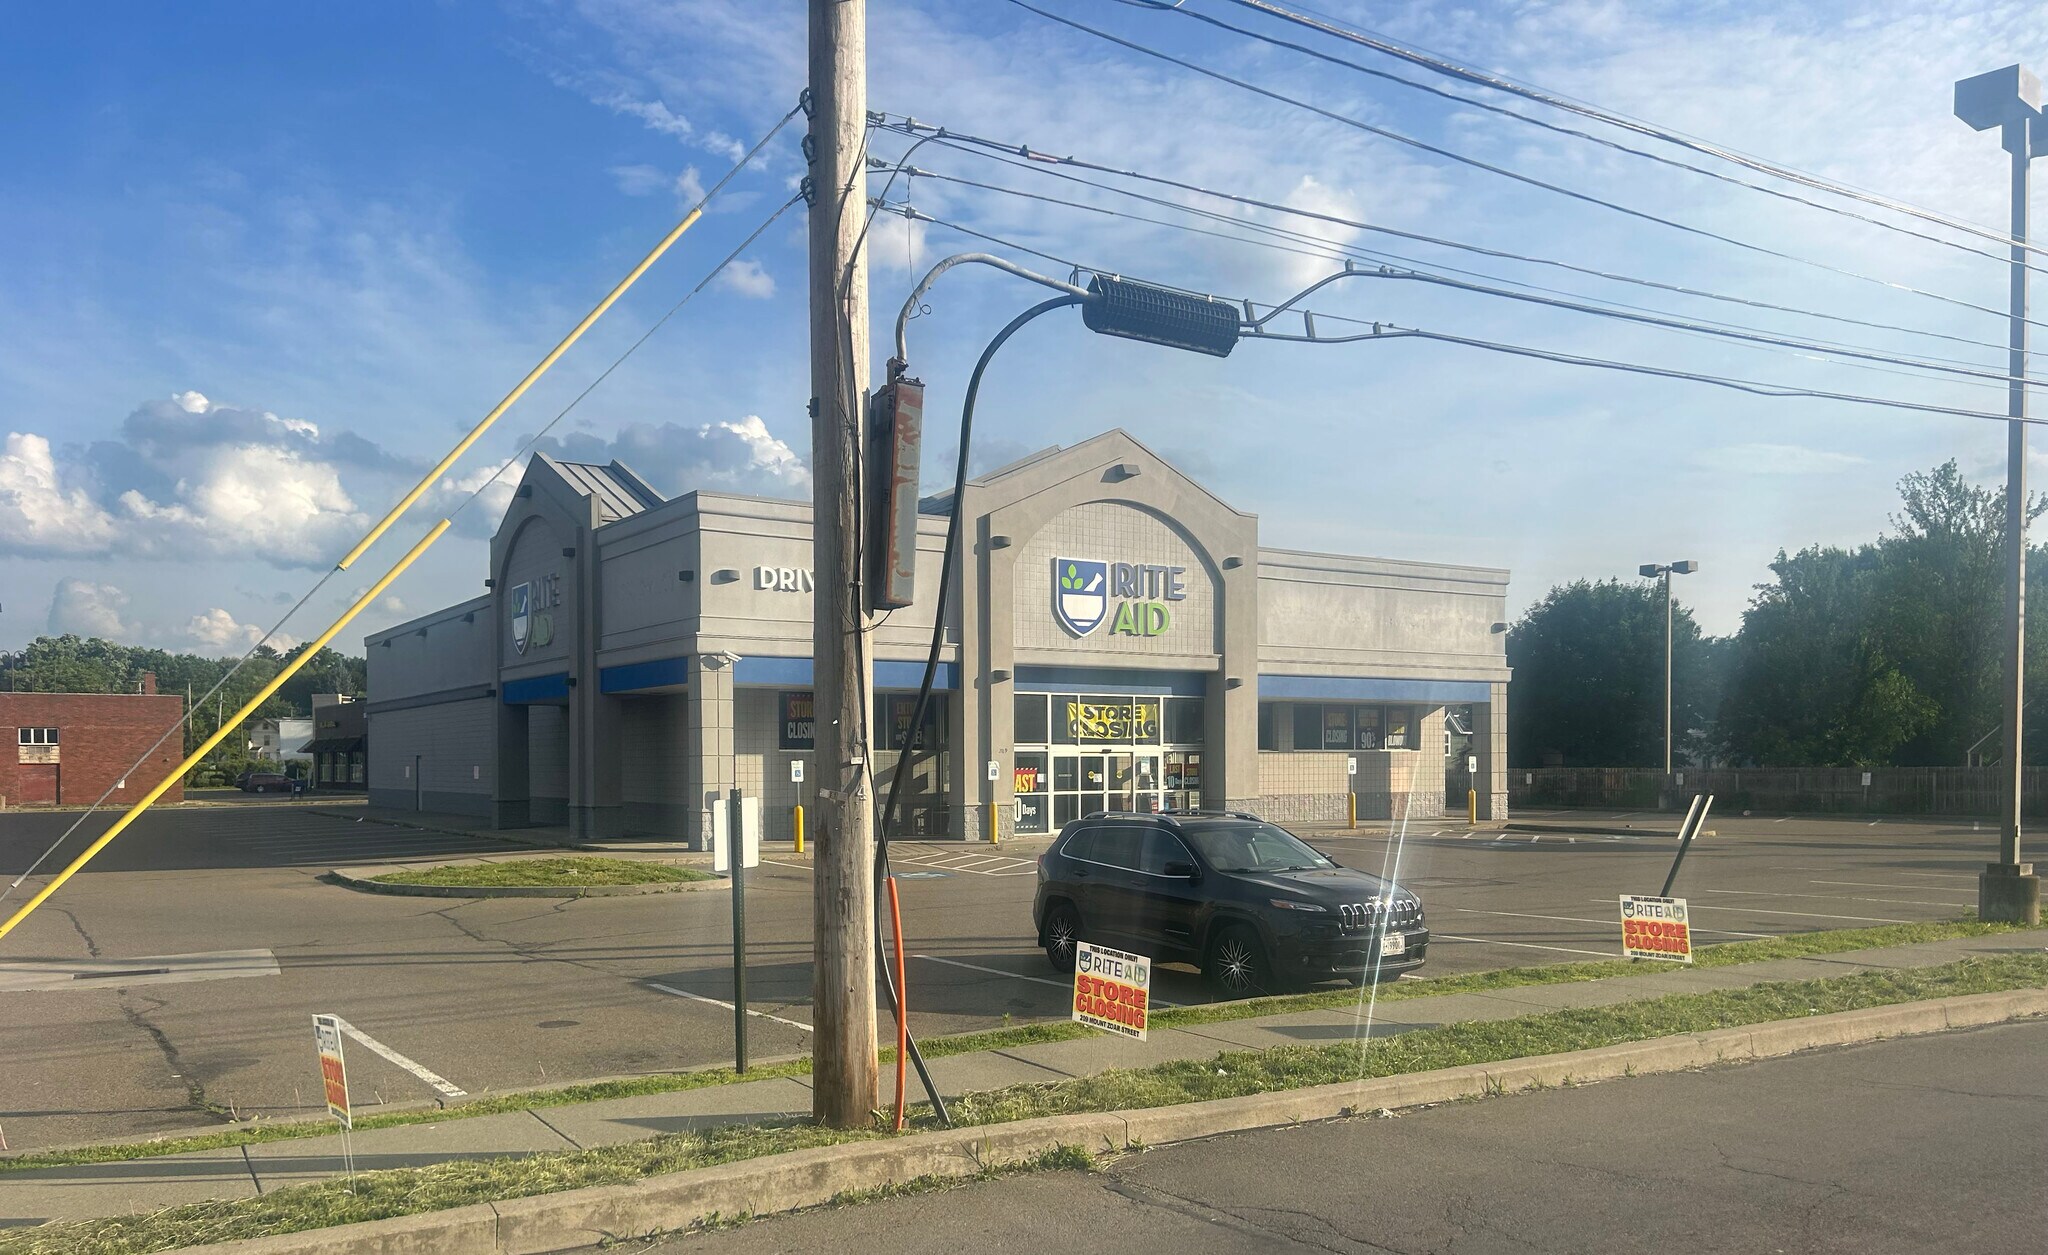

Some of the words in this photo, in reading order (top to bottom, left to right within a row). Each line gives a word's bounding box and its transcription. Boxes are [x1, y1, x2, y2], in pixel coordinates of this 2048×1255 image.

[1110, 562, 1186, 600] RITE
[1109, 601, 1170, 637] AID
[1083, 706, 1141, 721] STORE
[1070, 720, 1157, 738] CLOSING
[1015, 774, 1035, 792] AST
[1014, 797, 1022, 822] 0
[1022, 804, 1036, 816] Days
[1637, 904, 1663, 917] RITE
[1624, 919, 1687, 938] STORE
[1101, 947, 1124, 959] LOCATION
[1625, 933, 1689, 954] CLOSING
[1093, 956, 1123, 978] RITE
[1077, 974, 1147, 1009] STORE
[1075, 993, 1145, 1029] CLOSING
[1089, 1016, 1107, 1028] MOUNT
[1107, 1020, 1121, 1031] ZOAR
[1121, 1025, 1140, 1038] STREET
